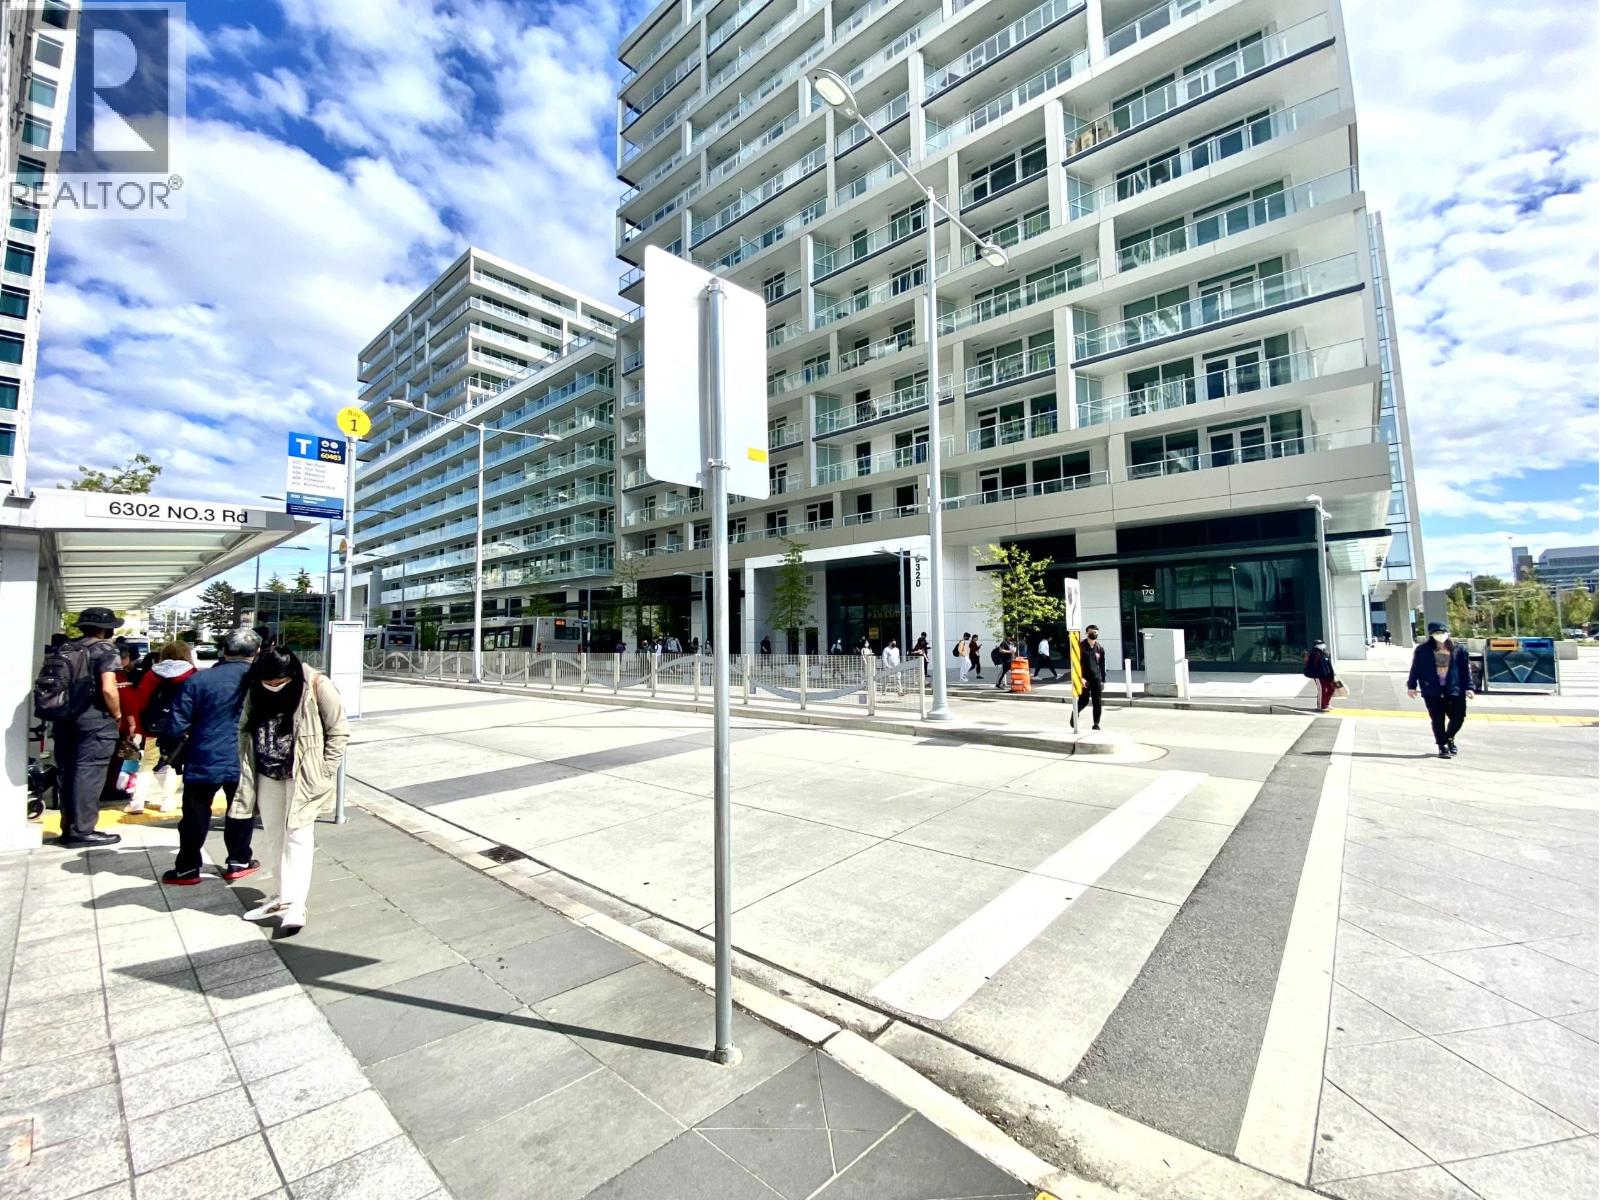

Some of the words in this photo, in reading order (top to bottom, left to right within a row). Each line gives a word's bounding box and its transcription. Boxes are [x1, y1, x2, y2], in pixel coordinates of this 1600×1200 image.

[350, 419, 358, 432] 1
[295, 438, 312, 455] T
[109, 501, 160, 518] 6302
[168, 505, 215, 522] NO.3
[222, 509, 249, 524] Rd
[1140, 588, 1155, 596] 170
